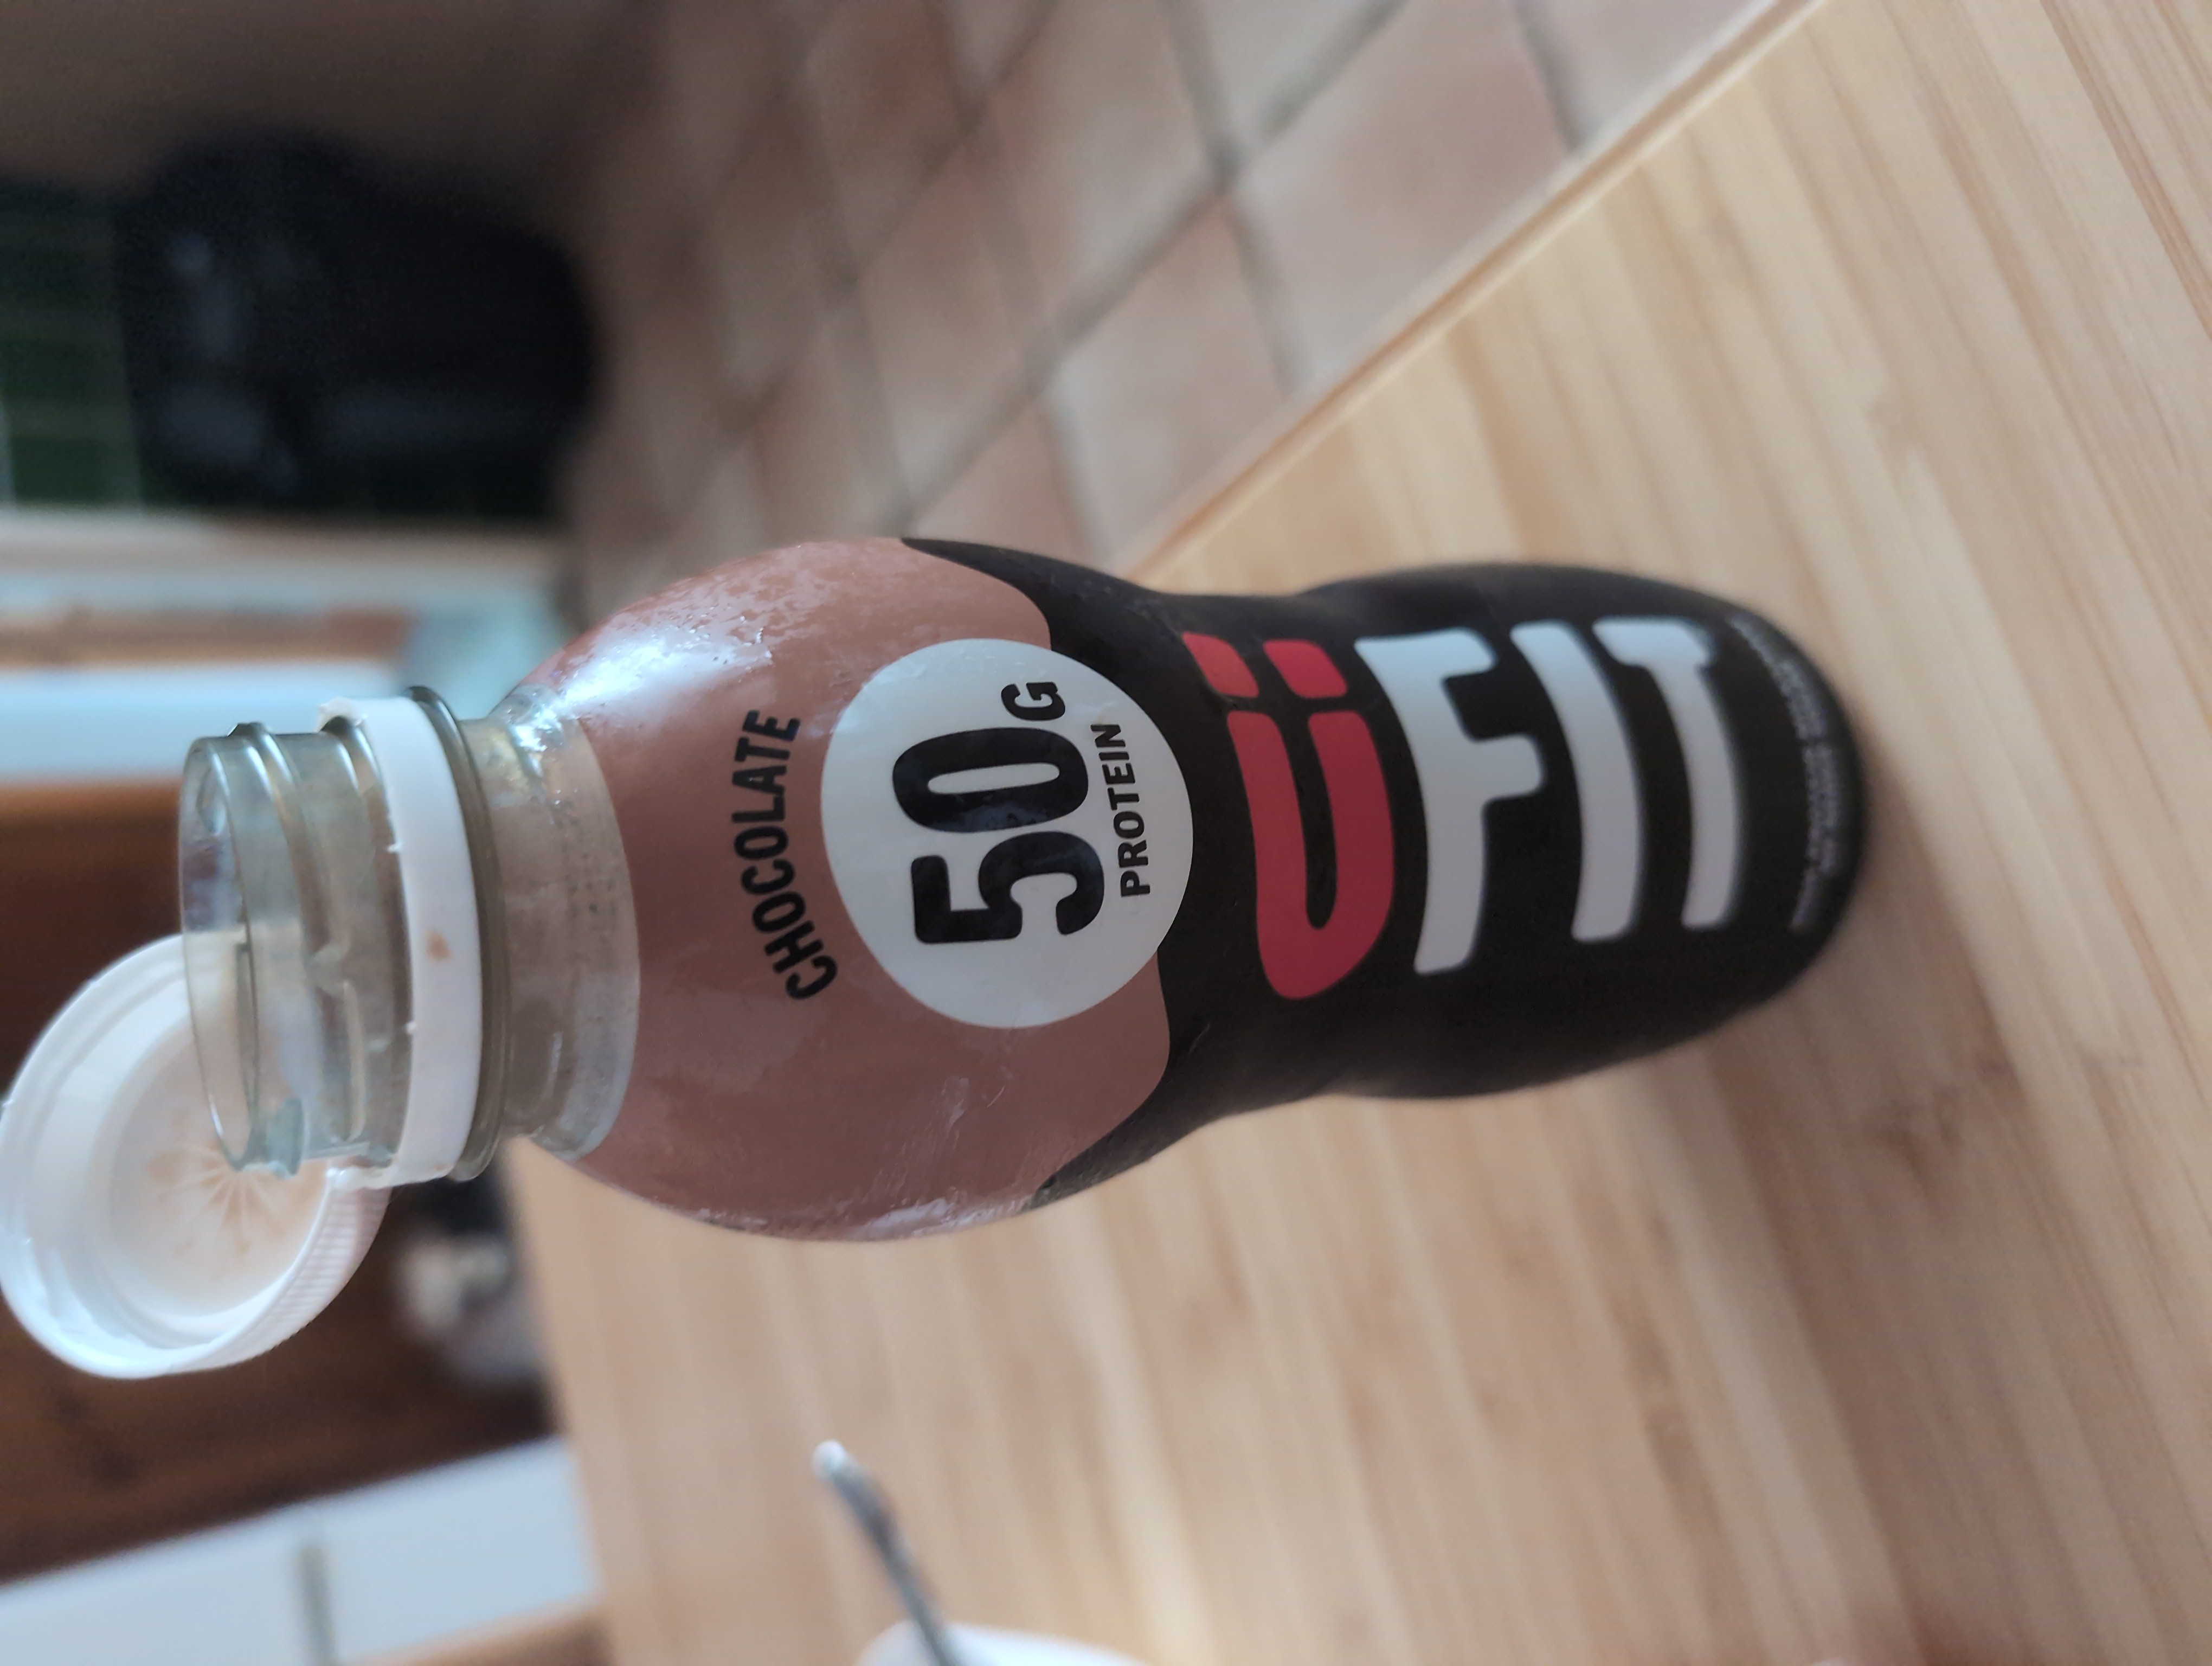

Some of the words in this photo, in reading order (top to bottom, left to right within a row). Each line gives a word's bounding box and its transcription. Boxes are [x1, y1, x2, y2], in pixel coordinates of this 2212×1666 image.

[731, 709, 838, 999] CHOCOLATE
[1090, 723, 1150, 898] PROTEIN
[1182, 616, 1741, 999] ÜFIT
